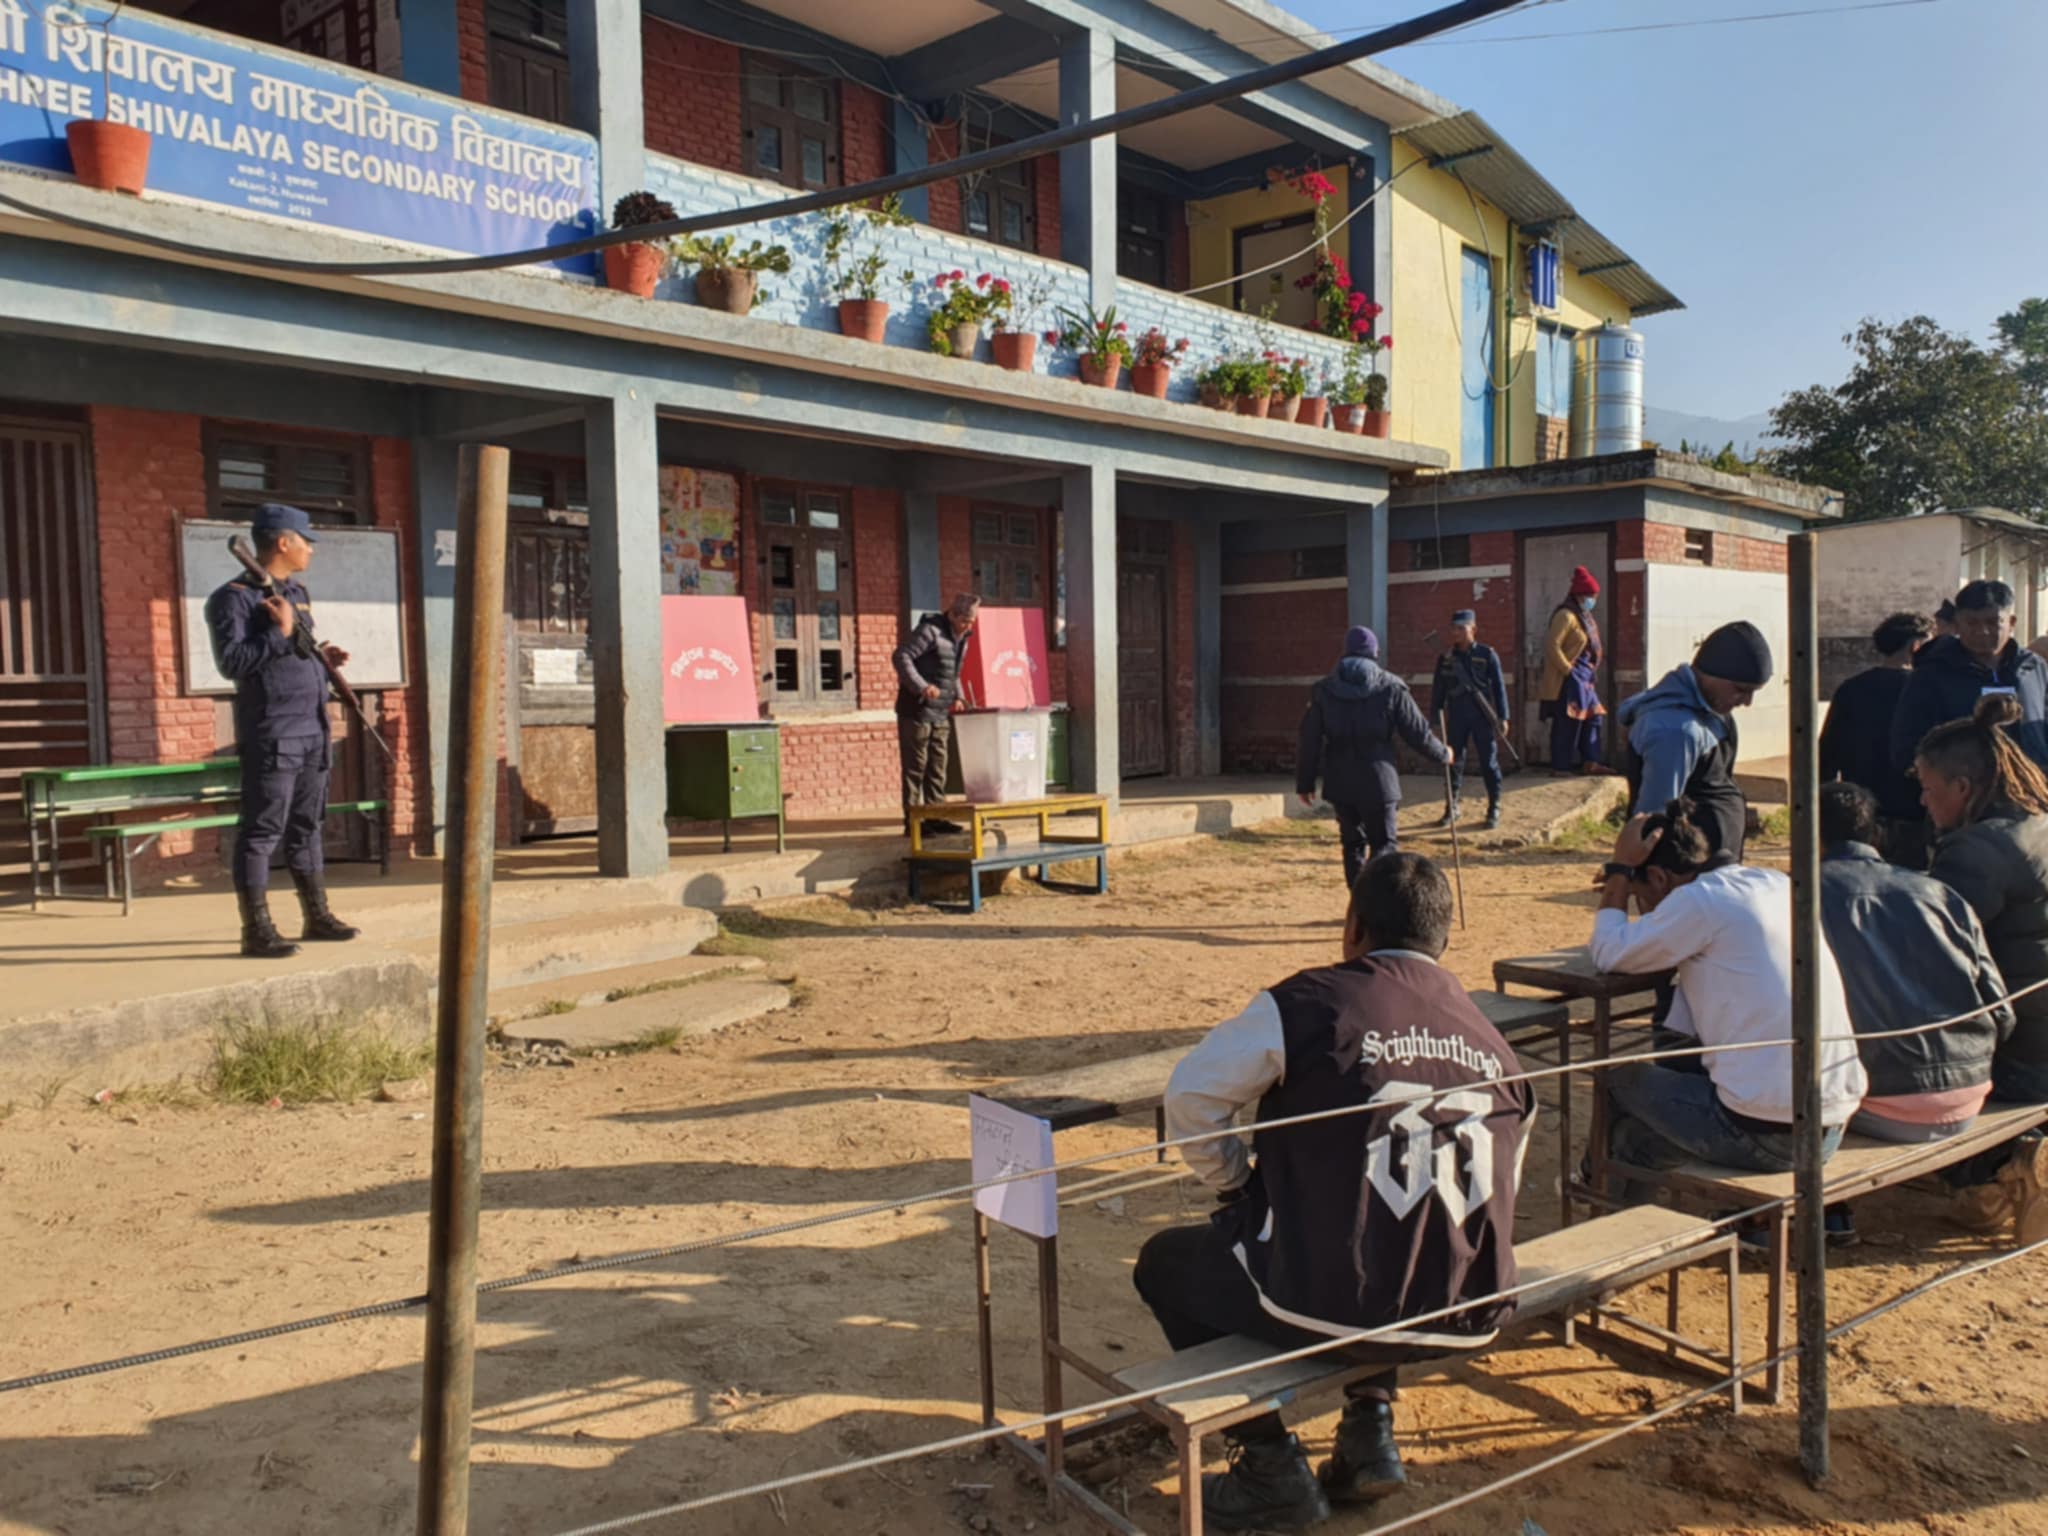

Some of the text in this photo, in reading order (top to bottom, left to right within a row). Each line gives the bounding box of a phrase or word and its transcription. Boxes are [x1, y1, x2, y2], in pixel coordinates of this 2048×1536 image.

[45, 3, 236, 104] शिवालय
[249, 72, 440, 151] माध्यमिक
[452, 114, 583, 189] विद्यालय
[106, 92, 294, 165] SHIVALAYA
[302, 140, 476, 204] SECONDARY
[484, 184, 586, 228] SCHOOL
